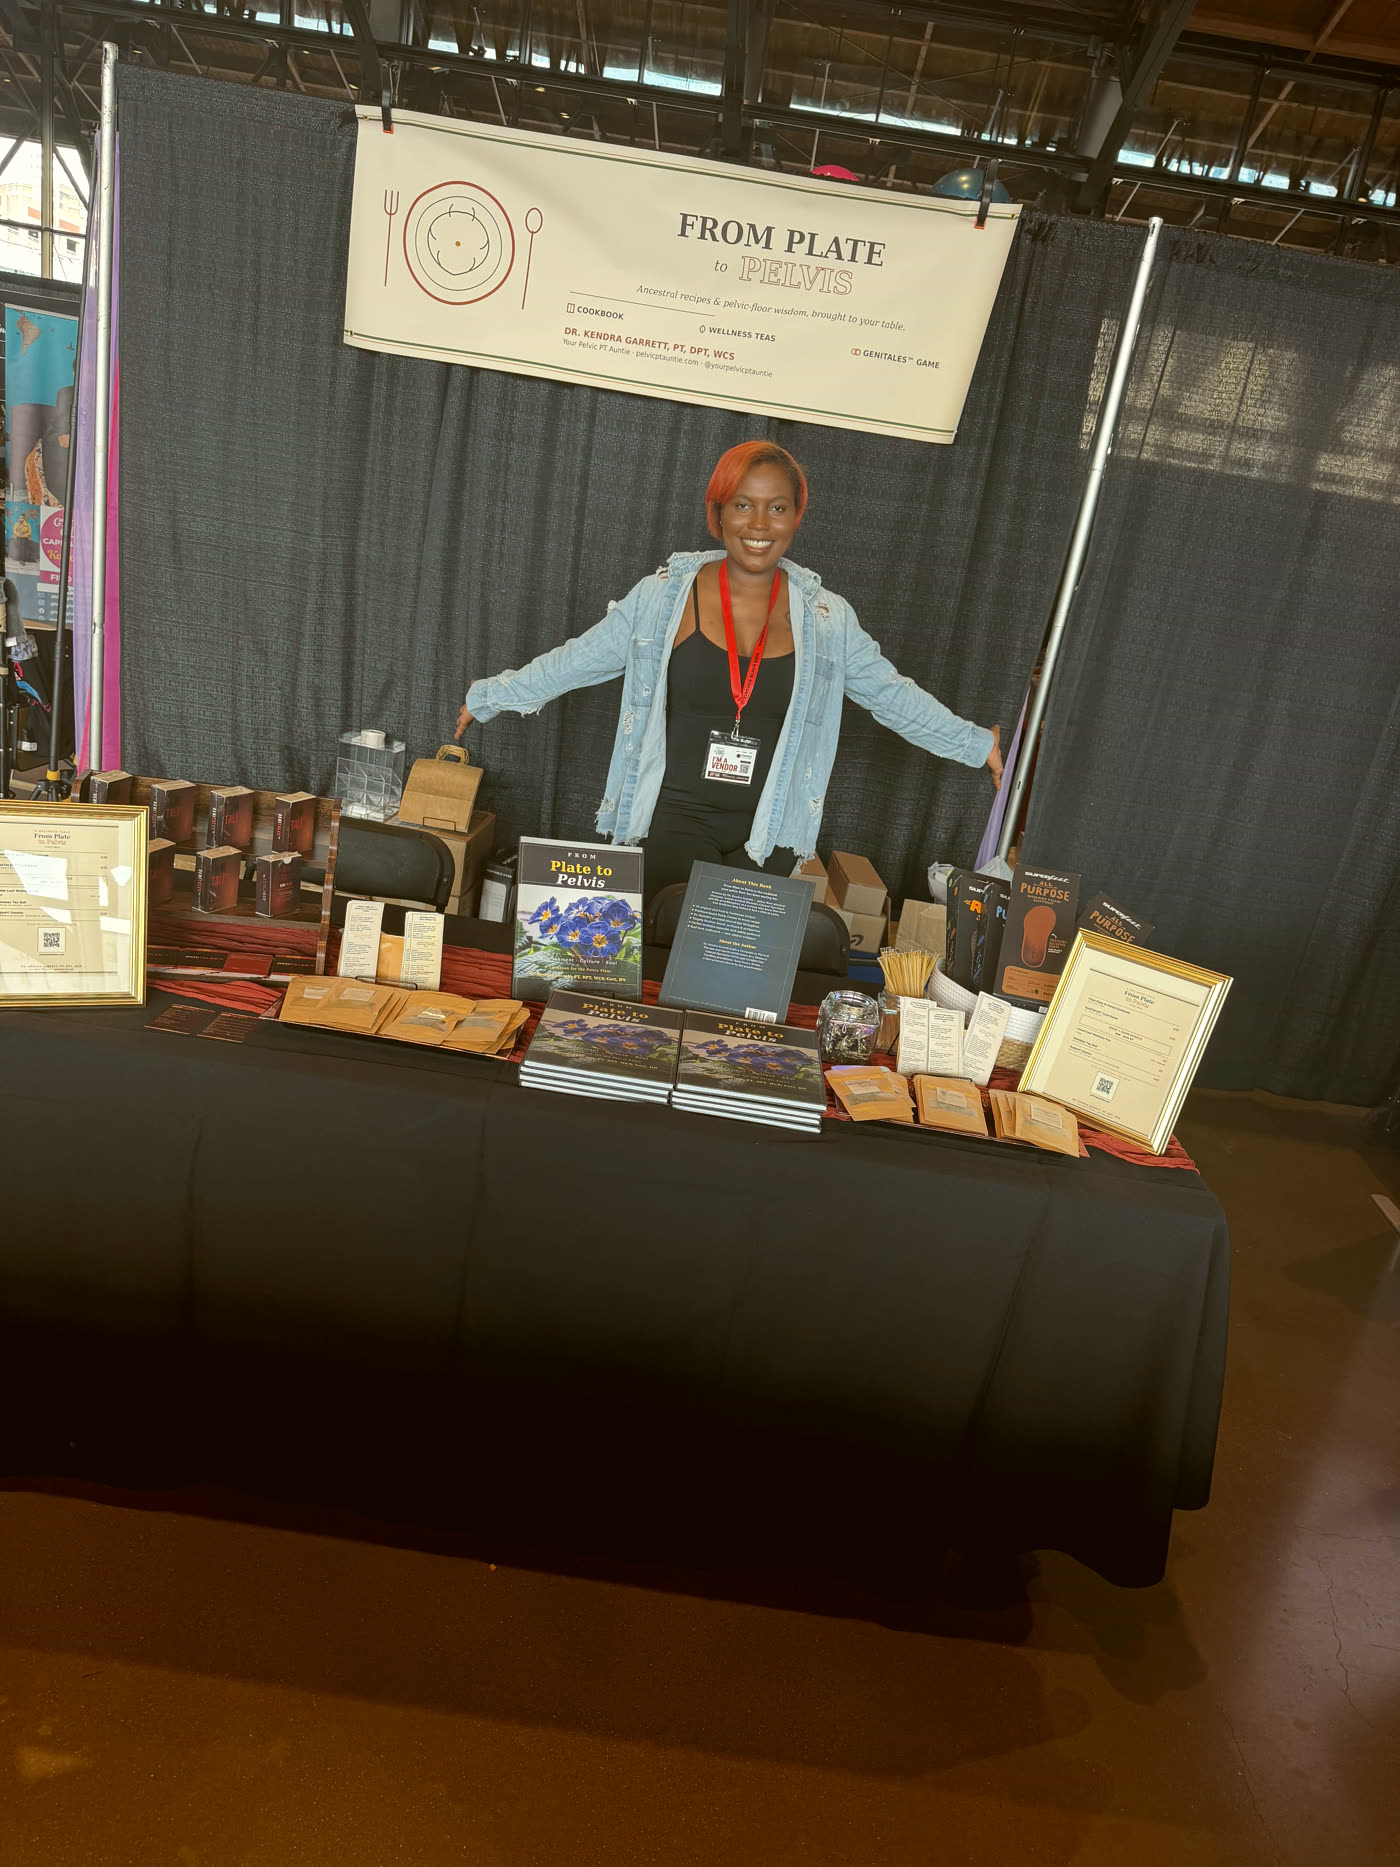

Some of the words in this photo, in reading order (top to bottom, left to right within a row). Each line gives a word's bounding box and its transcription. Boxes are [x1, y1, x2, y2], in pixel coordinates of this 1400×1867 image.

[678, 213, 776, 250] FROM
[784, 229, 886, 266] PLATE
[714, 260, 728, 272] to
[739, 256, 853, 295] PELVIS
[577, 306, 624, 320] COOKBOOK
[636, 285, 678, 299] Ancestral
[680, 293, 711, 305] recipes
[713, 298, 722, 306] &
[723, 299, 772, 314] pelvic-floor
[774, 306, 809, 318] wisdom,
[812, 309, 846, 323] brought
[848, 314, 857, 323] to
[859, 316, 879, 328] your
[881, 319, 906, 331] table.
[709, 326, 752, 339] WELLNESS
[755, 333, 776, 342] TEAS
[564, 327, 581, 337] DR.
[584, 330, 622, 343] KENDRA
[625, 336, 670, 351] GARRETT,
[673, 343, 686, 354] PT,
[690, 346, 710, 357] DPT,
[714, 350, 735, 360] WCS
[563, 338, 576, 347] Your
[579, 340, 598, 350] Pelvic
[608, 345, 630, 355] Auntie
[636, 351, 699, 366] pelvicptauntie.com
[705, 361, 773, 377] @yourpelvicptauntie
[916, 358, 940, 369] GAME
[712, 762, 738, 772] VENDOR
[550, 860, 591, 875] Plate
[597, 865, 613, 876] to
[556, 874, 606, 888] Pelvis
[1020, 883, 1070, 901] PURPOSE
[1090, 911, 1135, 943] PURPOSE
[1111, 916, 1123, 926] ALL
[1124, 990, 1140, 1000] From
[1140, 996, 1154, 1004] Plate
[582, 1003, 625, 1015] Plate
[587, 1010, 640, 1023] Pelvis
[718, 1023, 760, 1034] Plate
[725, 1030, 776, 1042] Pelvis
